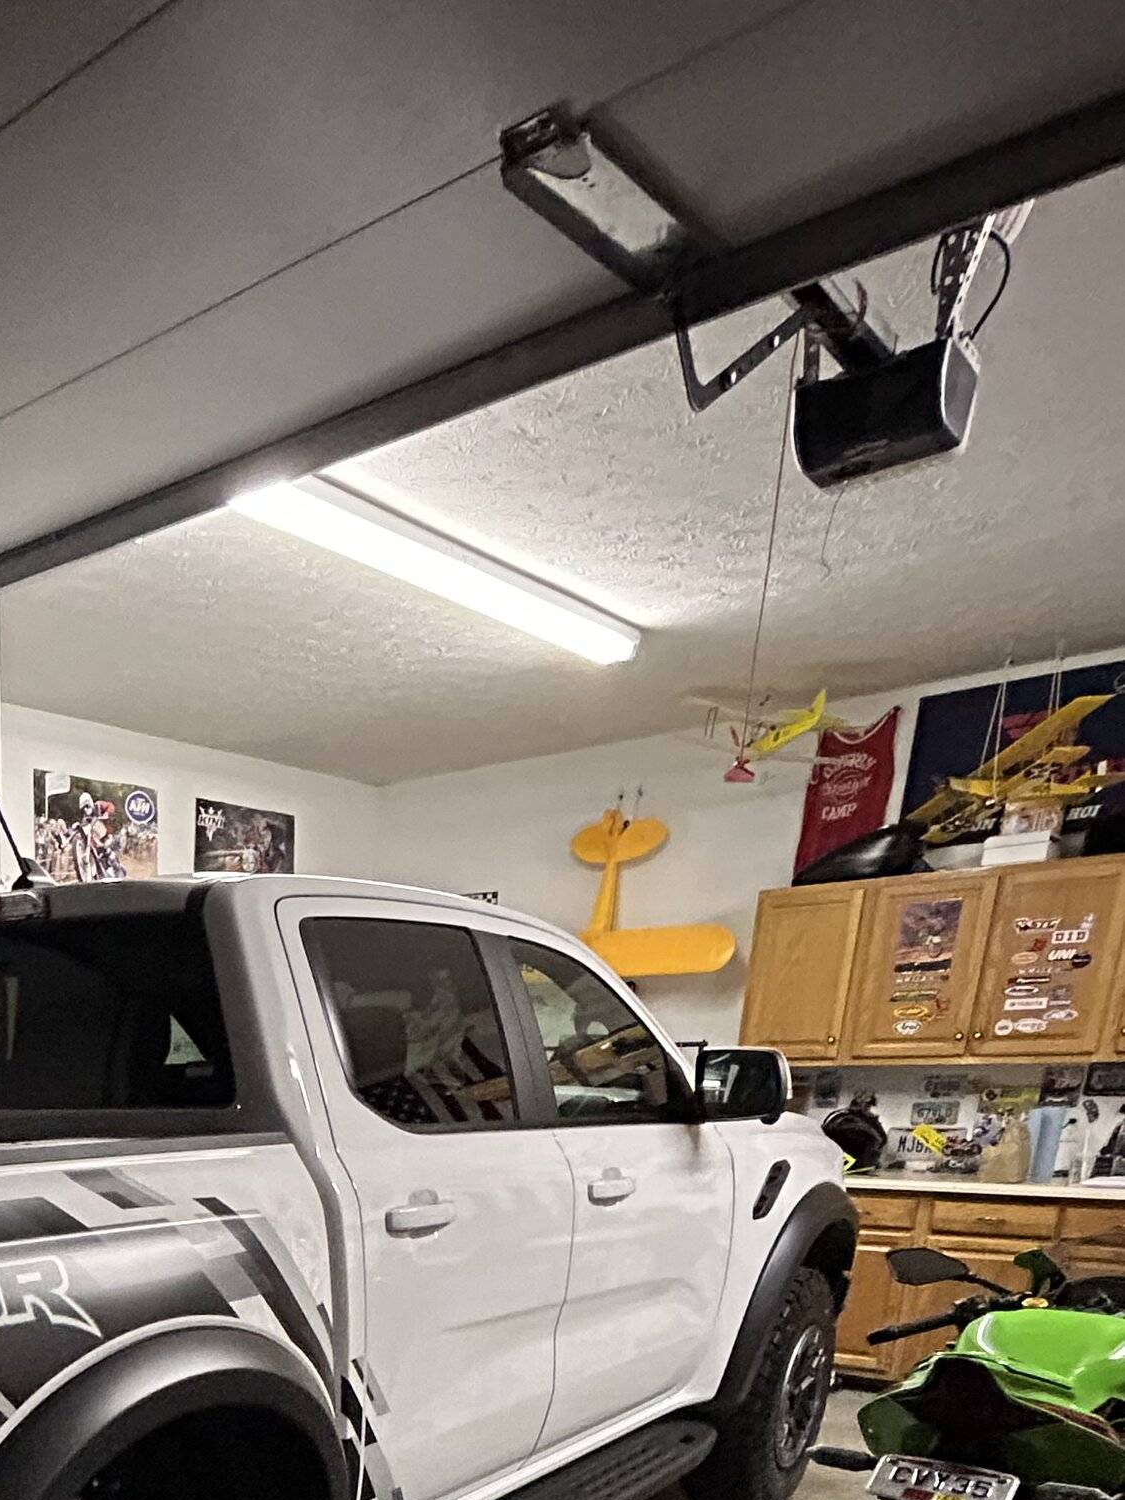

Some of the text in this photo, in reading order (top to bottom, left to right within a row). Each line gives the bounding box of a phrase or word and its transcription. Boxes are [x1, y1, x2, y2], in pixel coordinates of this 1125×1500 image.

[129, 797, 150, 814] KTM
[821, 802, 857, 820] CAMP
[1054, 931, 1087, 942] DID
